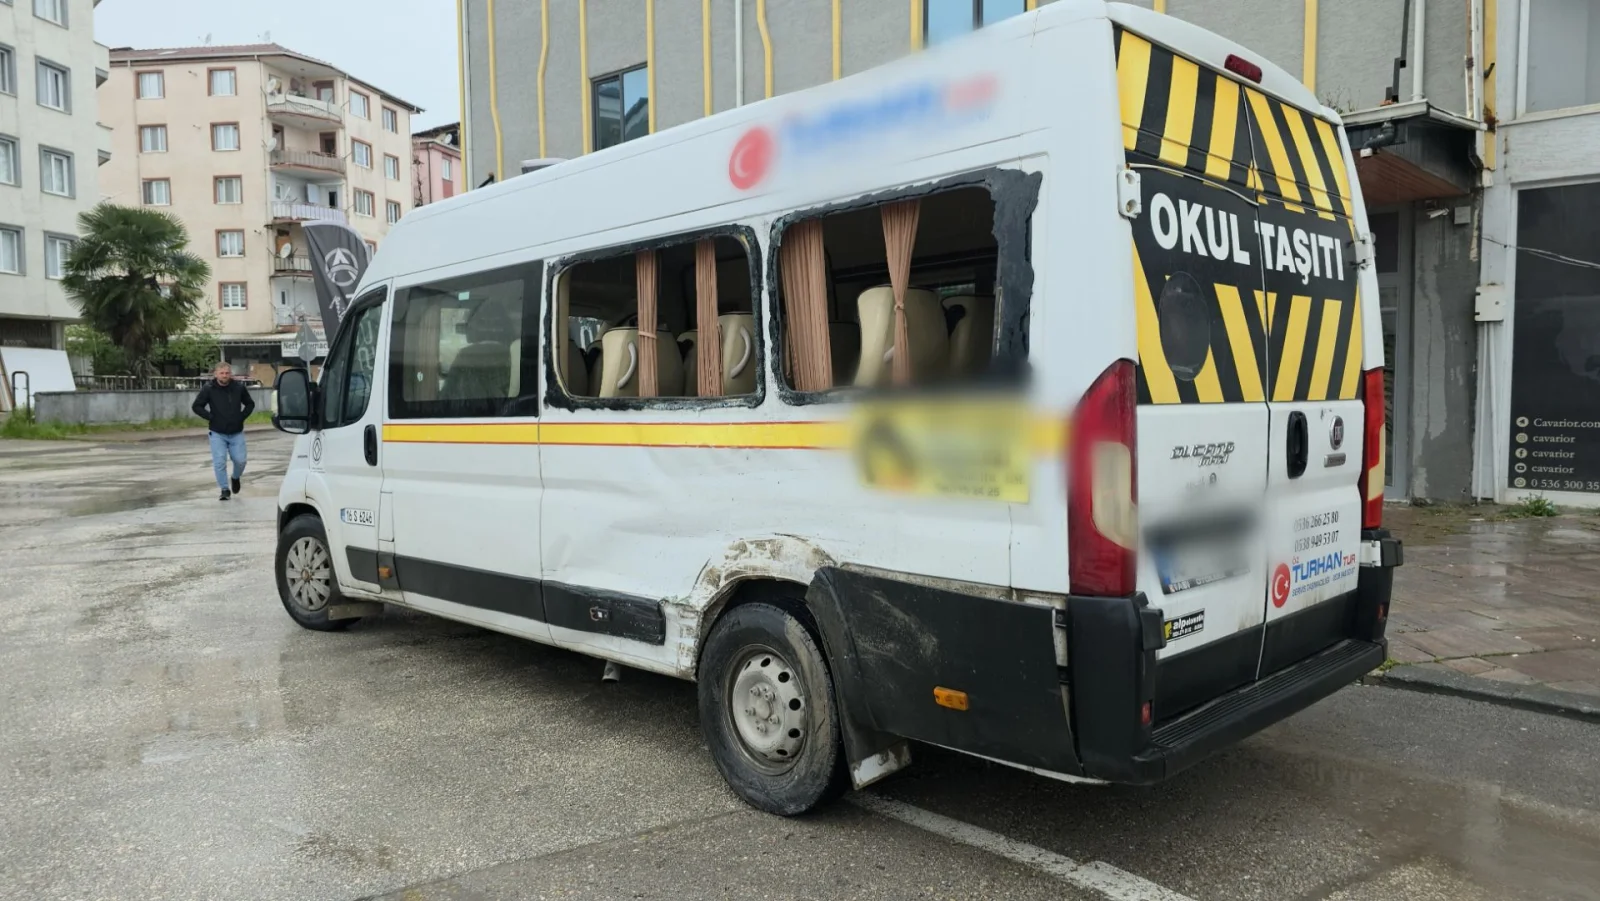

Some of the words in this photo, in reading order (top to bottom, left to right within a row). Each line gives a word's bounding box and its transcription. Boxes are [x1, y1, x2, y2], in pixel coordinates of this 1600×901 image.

[1150, 193, 1250, 265] OKUL
[1254, 220, 1345, 285] TAŞITI
[1533, 434, 1575, 443] cavarior
[1532, 449, 1575, 458] cavarior
[1531, 465, 1574, 474] cavarior
[1531, 478, 1538, 487] 0
[1541, 479, 1560, 489] 536
[1563, 480, 1583, 490] 300
[1586, 481, 1600, 491] 35
[346, 511, 352, 522] 16
[353, 510, 358, 522] S
[359, 512, 373, 524] 6246
[1322, 512, 1331, 526] 25
[1331, 511, 1339, 524] 80
[1322, 531, 1331, 546] 53
[1331, 530, 1339, 543] 07
[1292, 550, 1342, 583] TURHAN
[1343, 553, 1356, 567] TUR
